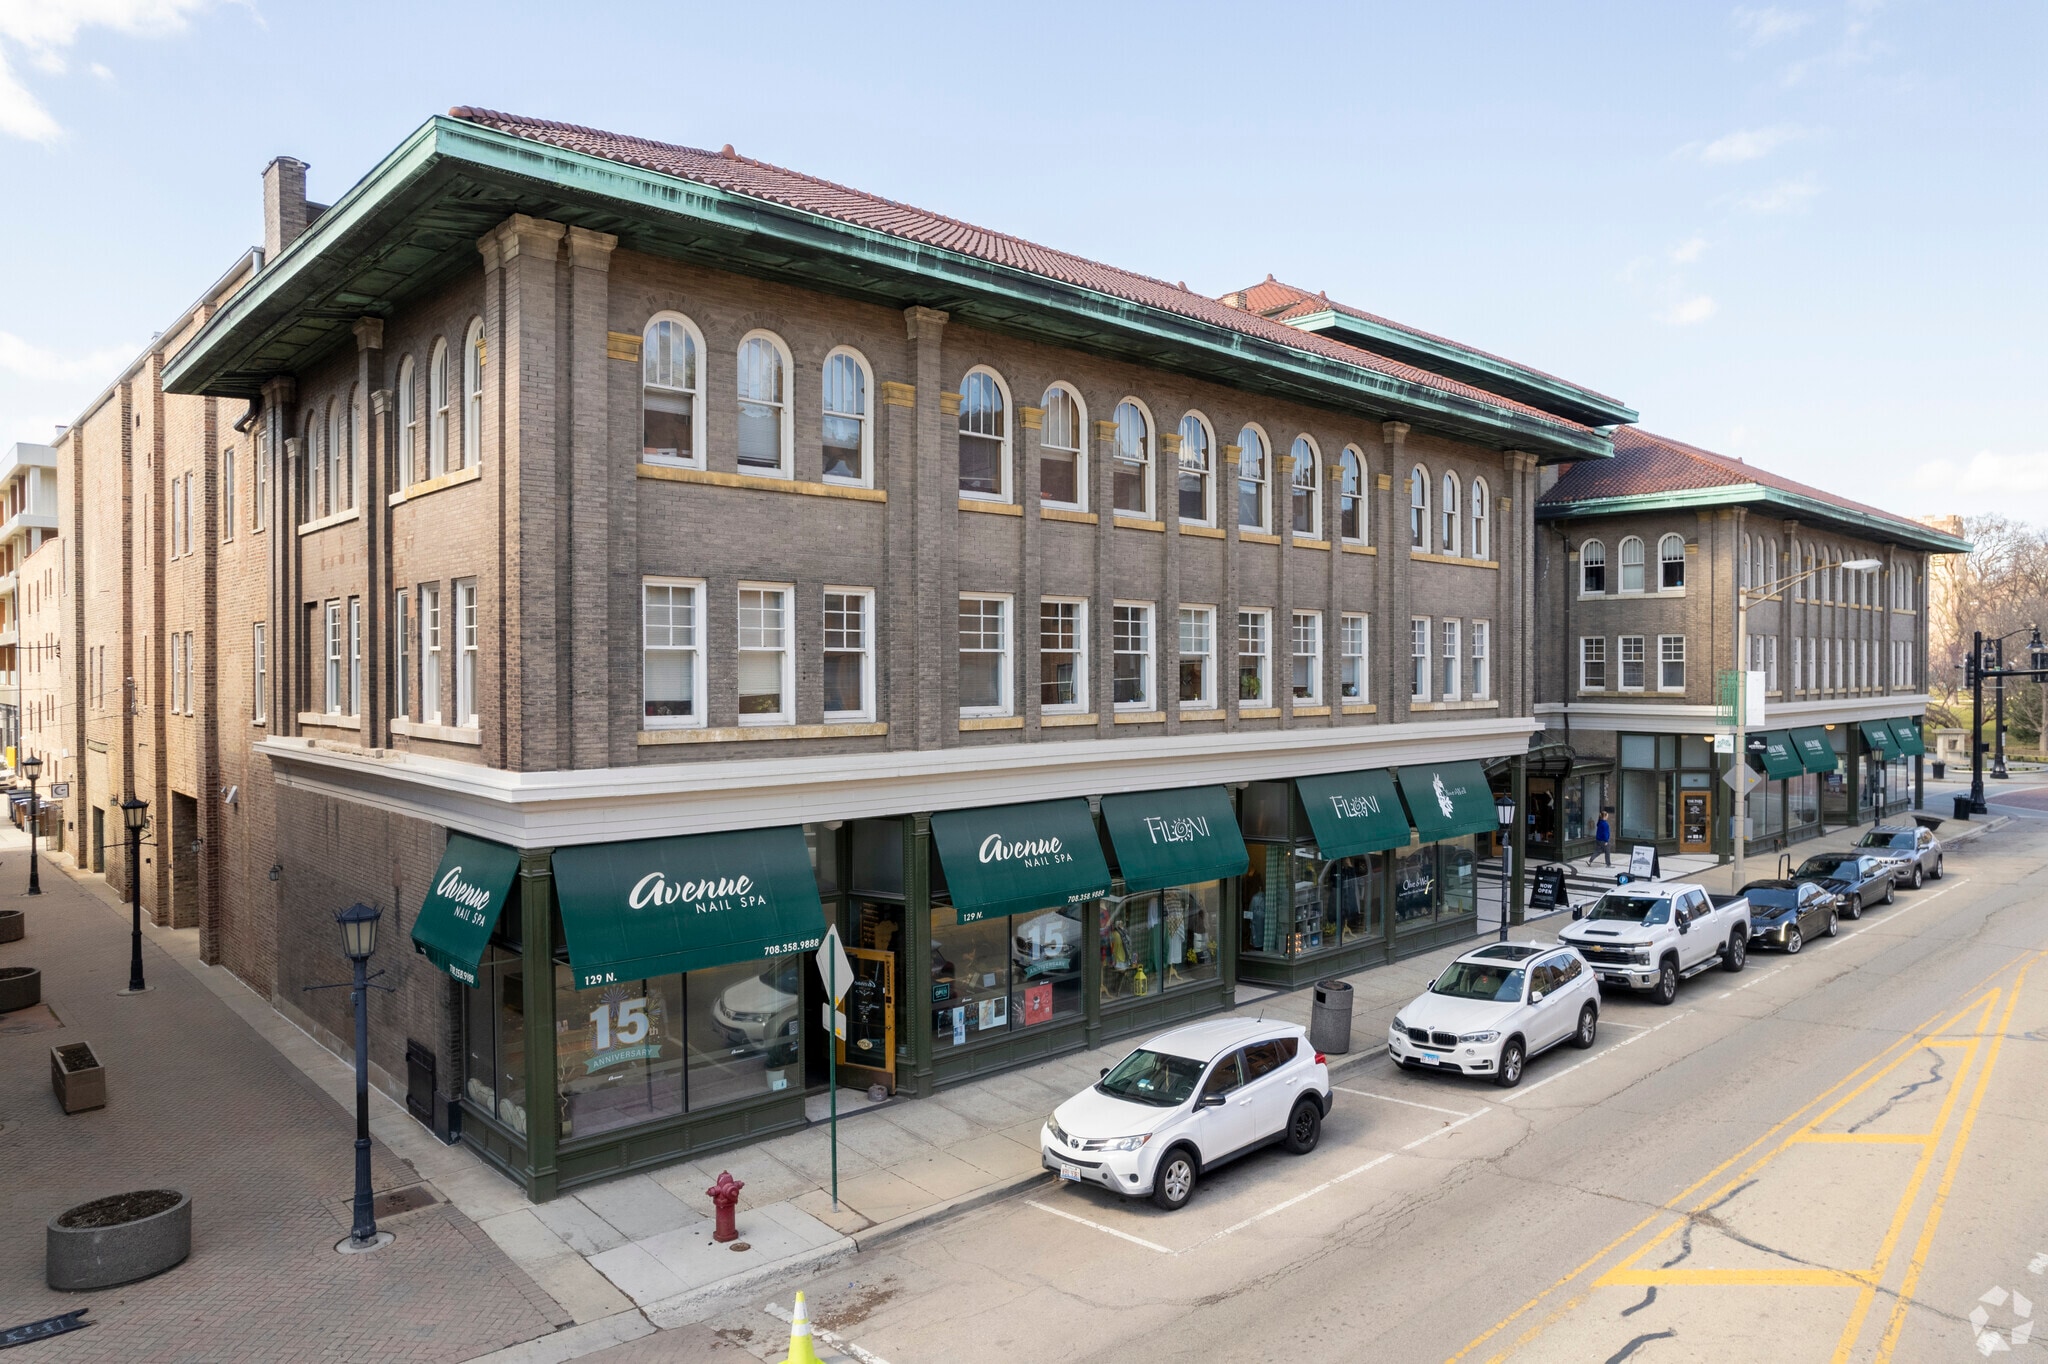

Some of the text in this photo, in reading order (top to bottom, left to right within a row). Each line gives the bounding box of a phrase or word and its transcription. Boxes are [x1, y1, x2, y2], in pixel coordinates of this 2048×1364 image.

[1329, 795, 1381, 819] FILONI
[1143, 815, 1211, 844] FILONI
[979, 833, 1063, 864] Avenue
[1023, 852, 1074, 868] NAIL SPA
[437, 866, 490, 910] Avenue
[628, 871, 755, 910] Avenue
[695, 894, 767, 914] NAIL SPA
[453, 905, 487, 928] NAIL SPA
[963, 912, 976, 922] 129
[763, 938, 820, 956] 708.358.9888
[584, 971, 618, 986] 129 N.
[592, 1048, 654, 1069] ANNIVERSARY
